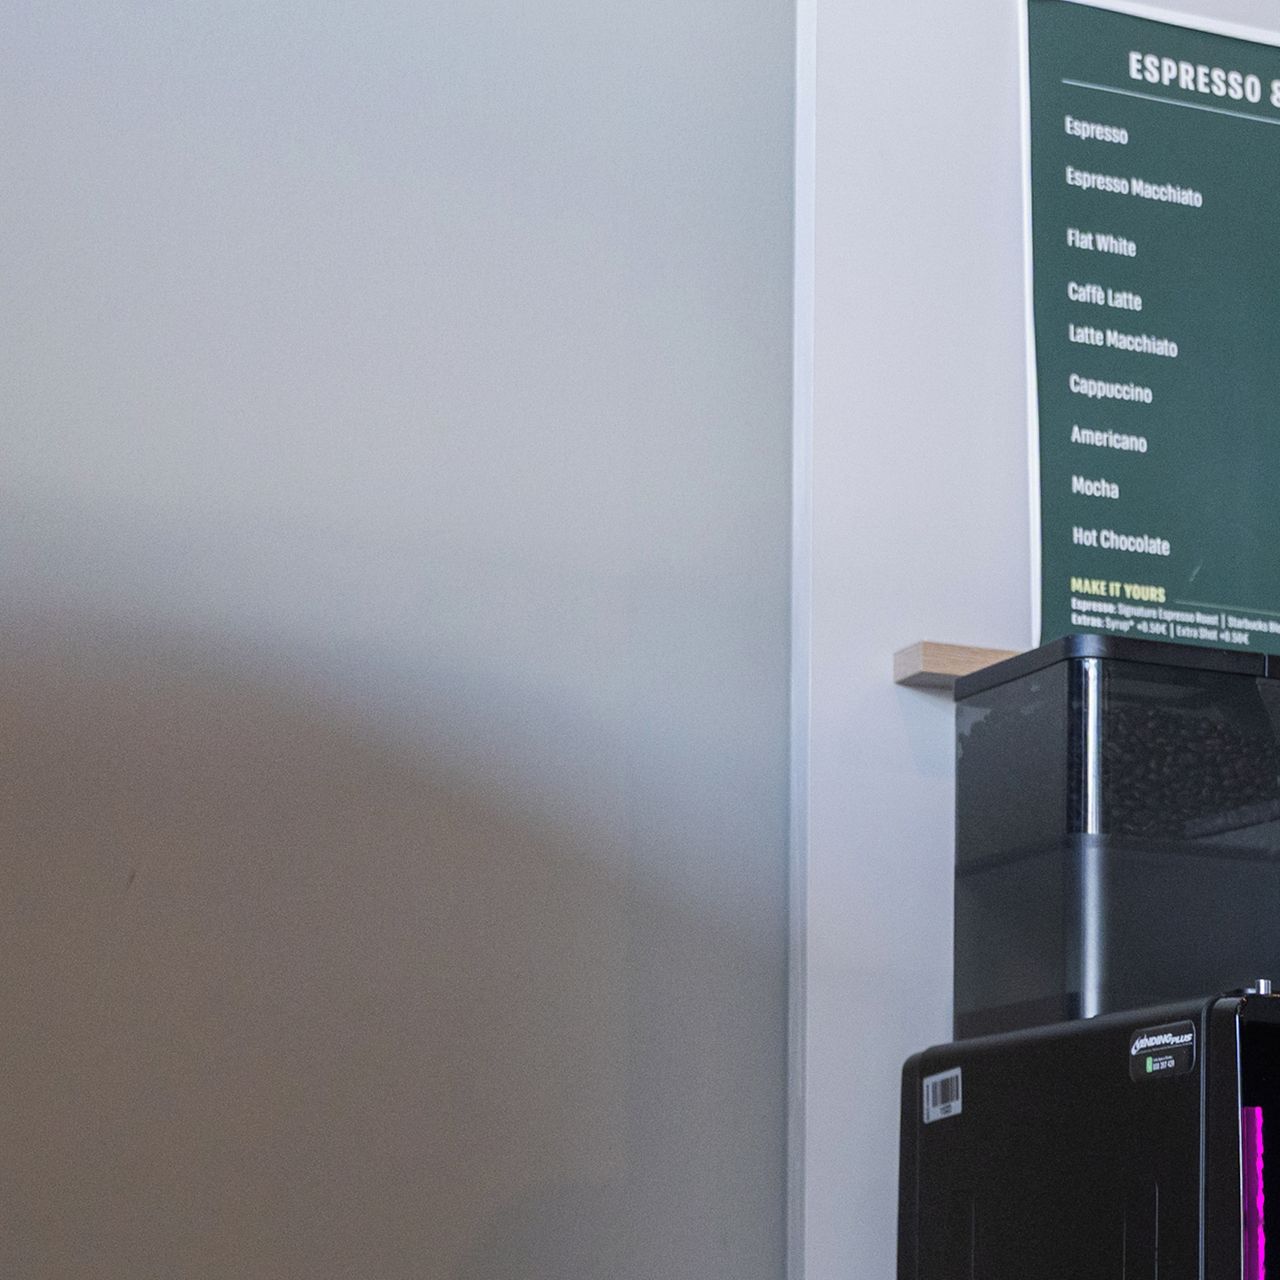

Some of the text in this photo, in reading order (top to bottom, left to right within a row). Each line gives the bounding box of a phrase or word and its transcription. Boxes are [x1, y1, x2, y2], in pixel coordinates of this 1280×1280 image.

[1128, 51, 1261, 102] ESPRESSO
[1065, 115, 1129, 145] Espresso
[1066, 166, 1203, 207] Espresso Macchiato
[1067, 227, 1137, 257] Flat White
[1068, 281, 1143, 311] Caffè Latte
[1069, 323, 1178, 358] Latte Macchiato
[1069, 373, 1153, 403] Cappuccino
[1071, 424, 1148, 453] Americano
[1072, 475, 1120, 500] Mocha
[1072, 526, 1171, 556] Hot Chocolate
[1071, 577, 1166, 603] MAKE IT YOURS
